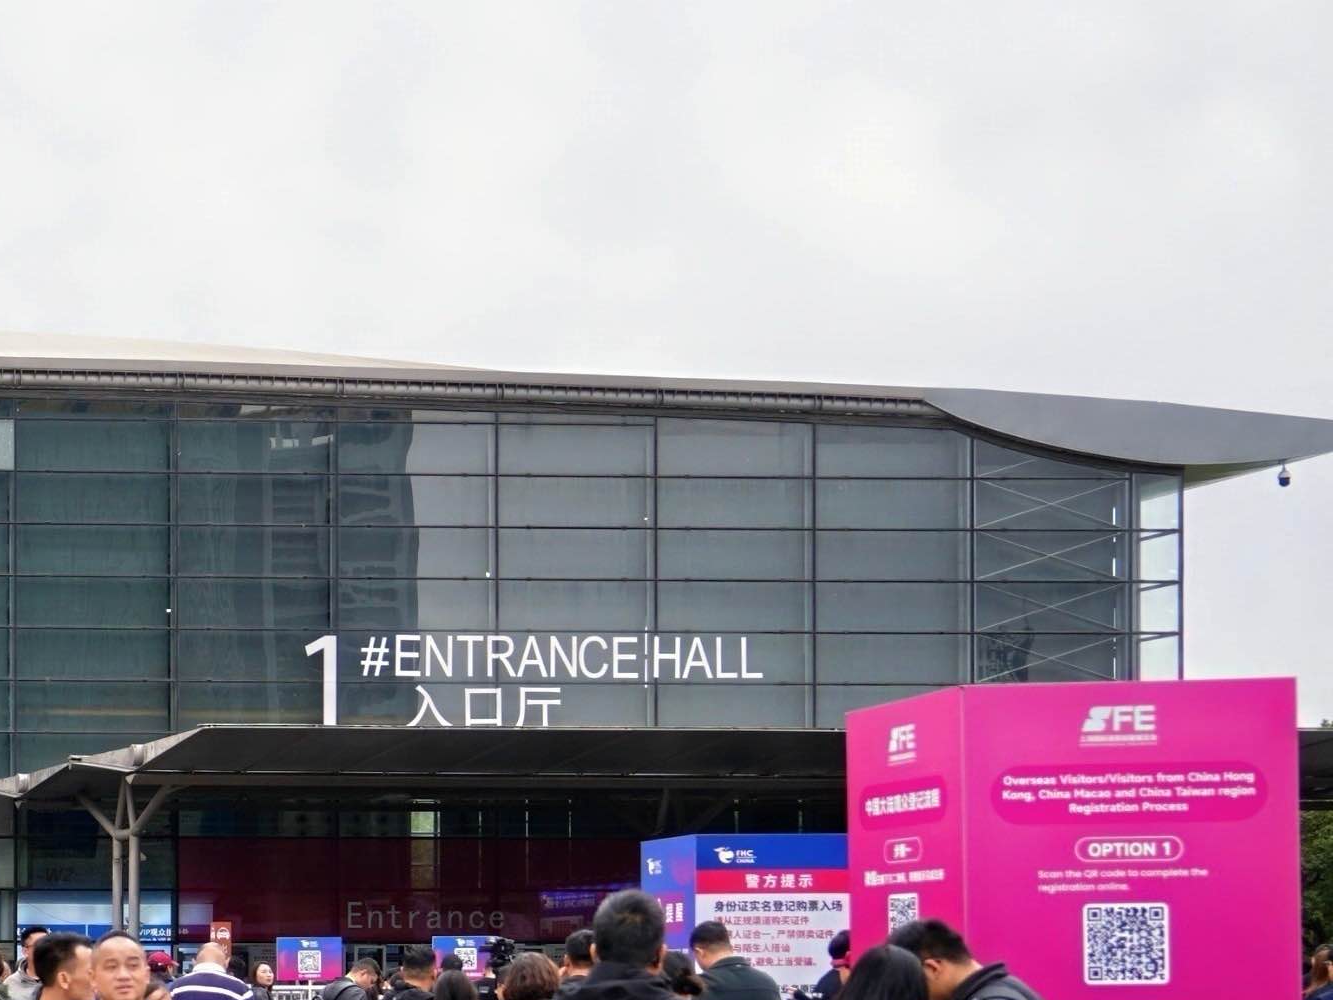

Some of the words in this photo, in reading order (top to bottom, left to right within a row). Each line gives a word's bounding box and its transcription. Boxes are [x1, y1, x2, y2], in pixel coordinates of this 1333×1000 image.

[304, 635, 337, 726] 1
[360, 635, 638, 678] #ENTRANCE
[653, 637, 763, 679] HALL
[407, 684, 562, 727] 入口厅
[1003, 775, 1056, 786] Overseas
[1059, 773, 1153, 785] Visitors/Visitors
[1157, 772, 1184, 783] from
[1188, 771, 1221, 783] China
[1223, 771, 1255, 784] Hong
[1002, 789, 1036, 801] Kong,
[1039, 789, 1071, 799] China
[1074, 788, 1111, 799] Macao
[1114, 788, 1135, 798] and
[1139, 787, 1171, 798] China
[1175, 786, 1215, 797] Taiwan
[1218, 786, 1255, 799] region
[1069, 803, 1139, 816] Registration
[1142, 802, 1189, 813] Process
[735, 849, 754, 857] FHC
[1087, 842, 1157, 858] OPTION
[1162, 841, 1171, 856] 1
[745, 873, 813, 889] 警方提示
[1037, 870, 1064, 879] Scan
[1065, 869, 1082, 879] the
[1084, 869, 1098, 879] QR
[1100, 869, 1126, 879] code
[1128, 869, 1138, 878] to
[1140, 868, 1189, 880] complete
[1190, 867, 1209, 877] the
[1038, 882, 1095, 895] registration
[1097, 881, 1129, 892] online.
[714, 900, 843, 912] 身份证实名登记购票入场
[346, 901, 505, 929] Entrance
